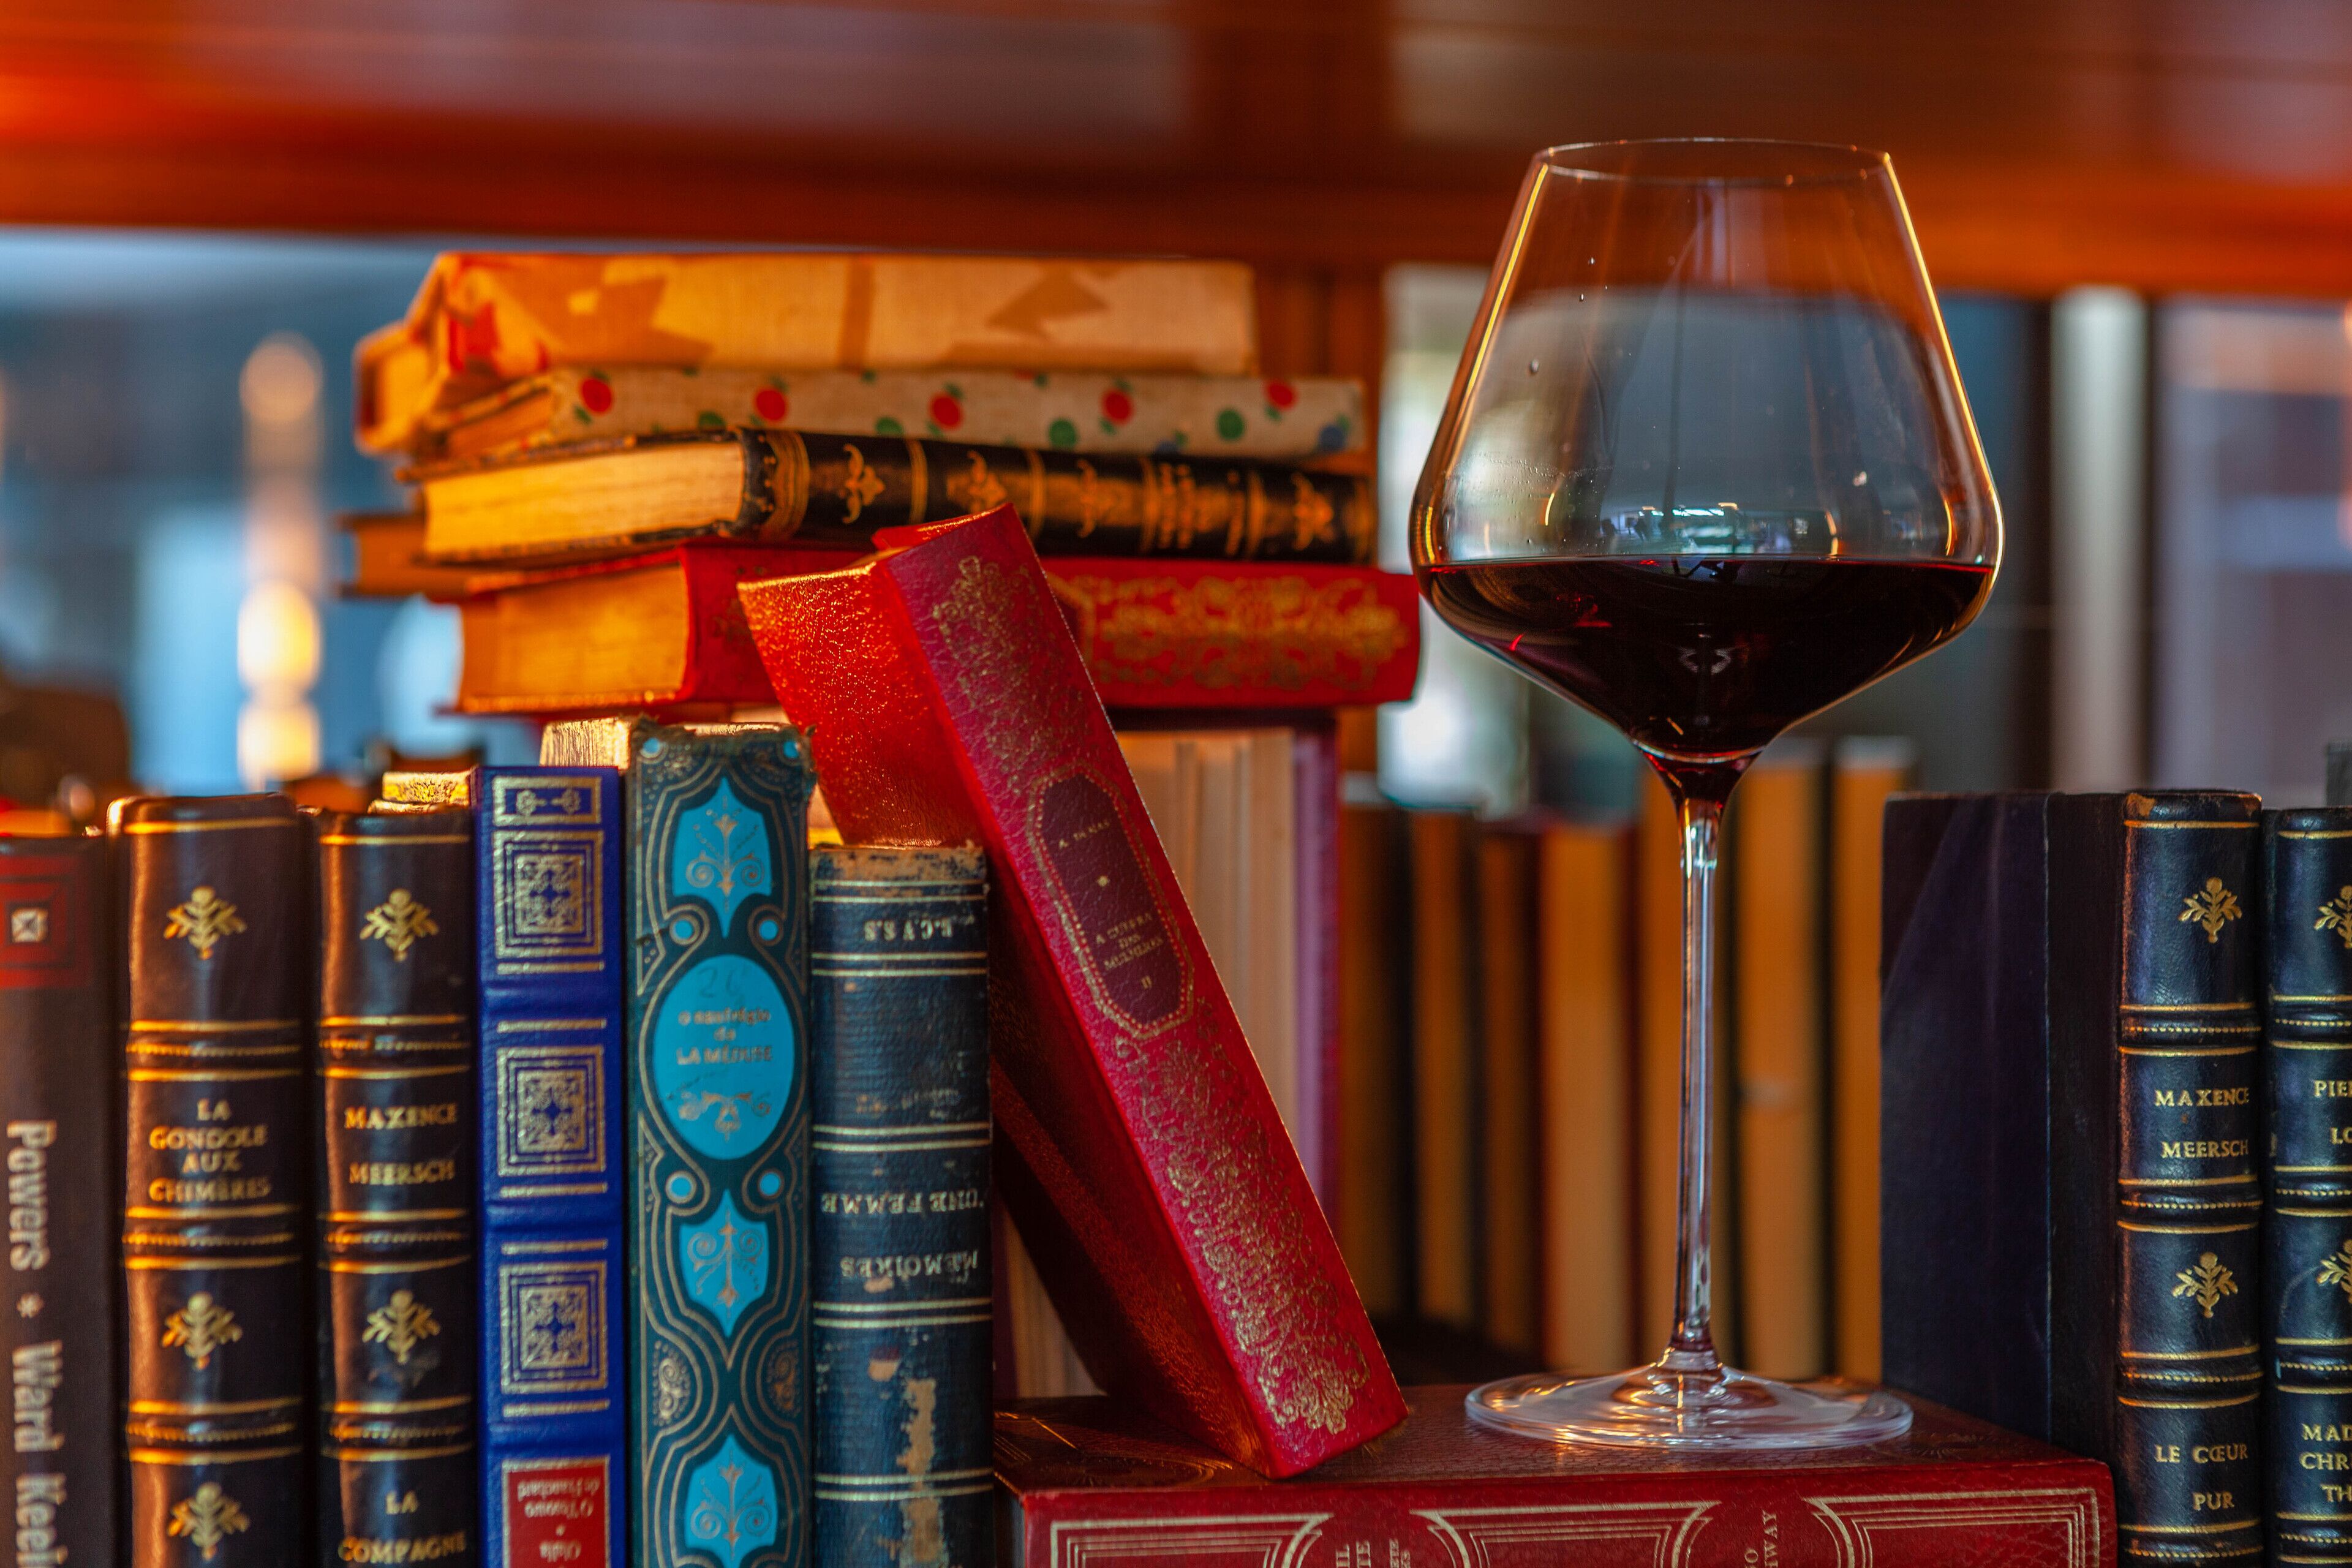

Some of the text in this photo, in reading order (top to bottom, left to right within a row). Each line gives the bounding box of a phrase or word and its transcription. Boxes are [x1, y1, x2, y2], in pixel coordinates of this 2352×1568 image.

[676, 1046, 701, 1066] LA
[197, 1098, 232, 1122] LA
[149, 1124, 268, 1151] GONDOLE
[2160, 1139, 2250, 1159] MEERSCH
[181, 1148, 243, 1174] AUX
[6, 1118, 58, 1271] Powers
[821, 1191, 924, 1215] FEMME
[12, 1339, 65, 1452] Ward
[2153, 1442, 2249, 1464] LE CŒUR
[2299, 1451, 2352, 1471] CHR
[385, 1490, 419, 1515] LA
[2192, 1491, 2236, 1511] PUR
